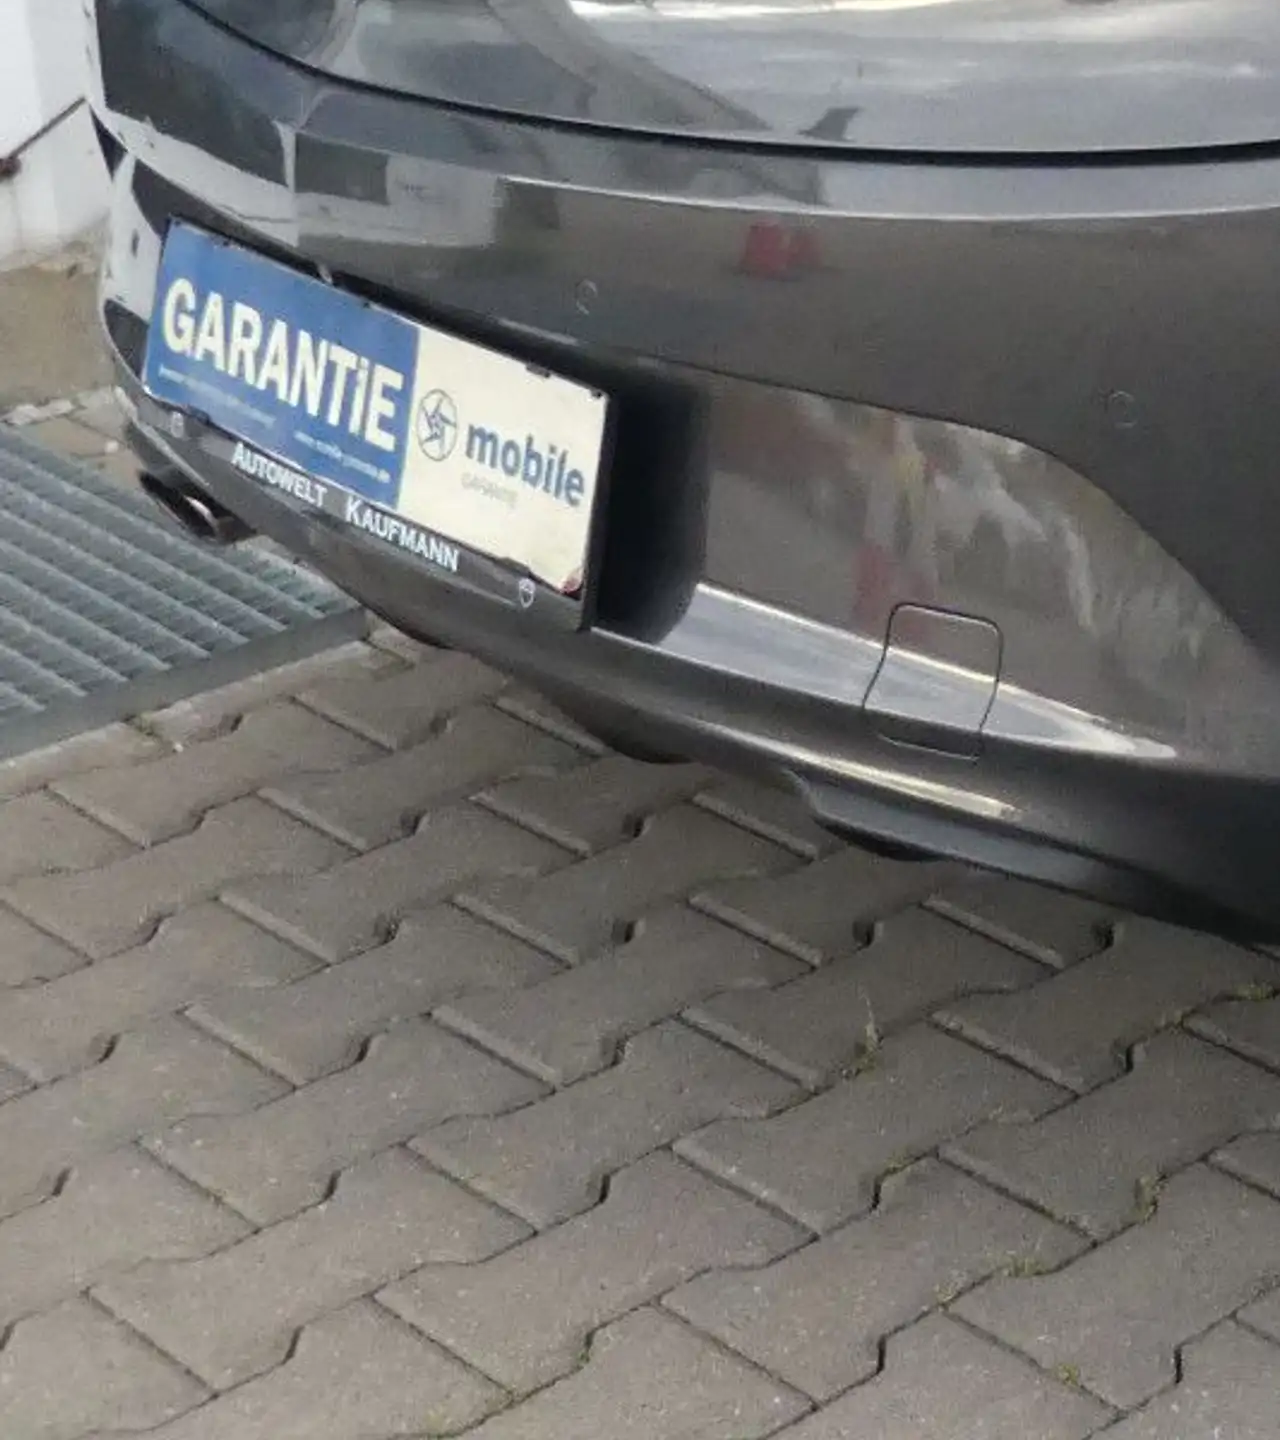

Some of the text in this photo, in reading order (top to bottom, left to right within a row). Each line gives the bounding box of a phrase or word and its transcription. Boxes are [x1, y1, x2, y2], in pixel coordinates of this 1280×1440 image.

[231, 441, 328, 508] AUTOWELT
[344, 494, 459, 572] KAUFMANN
[465, 423, 585, 507] mobile
